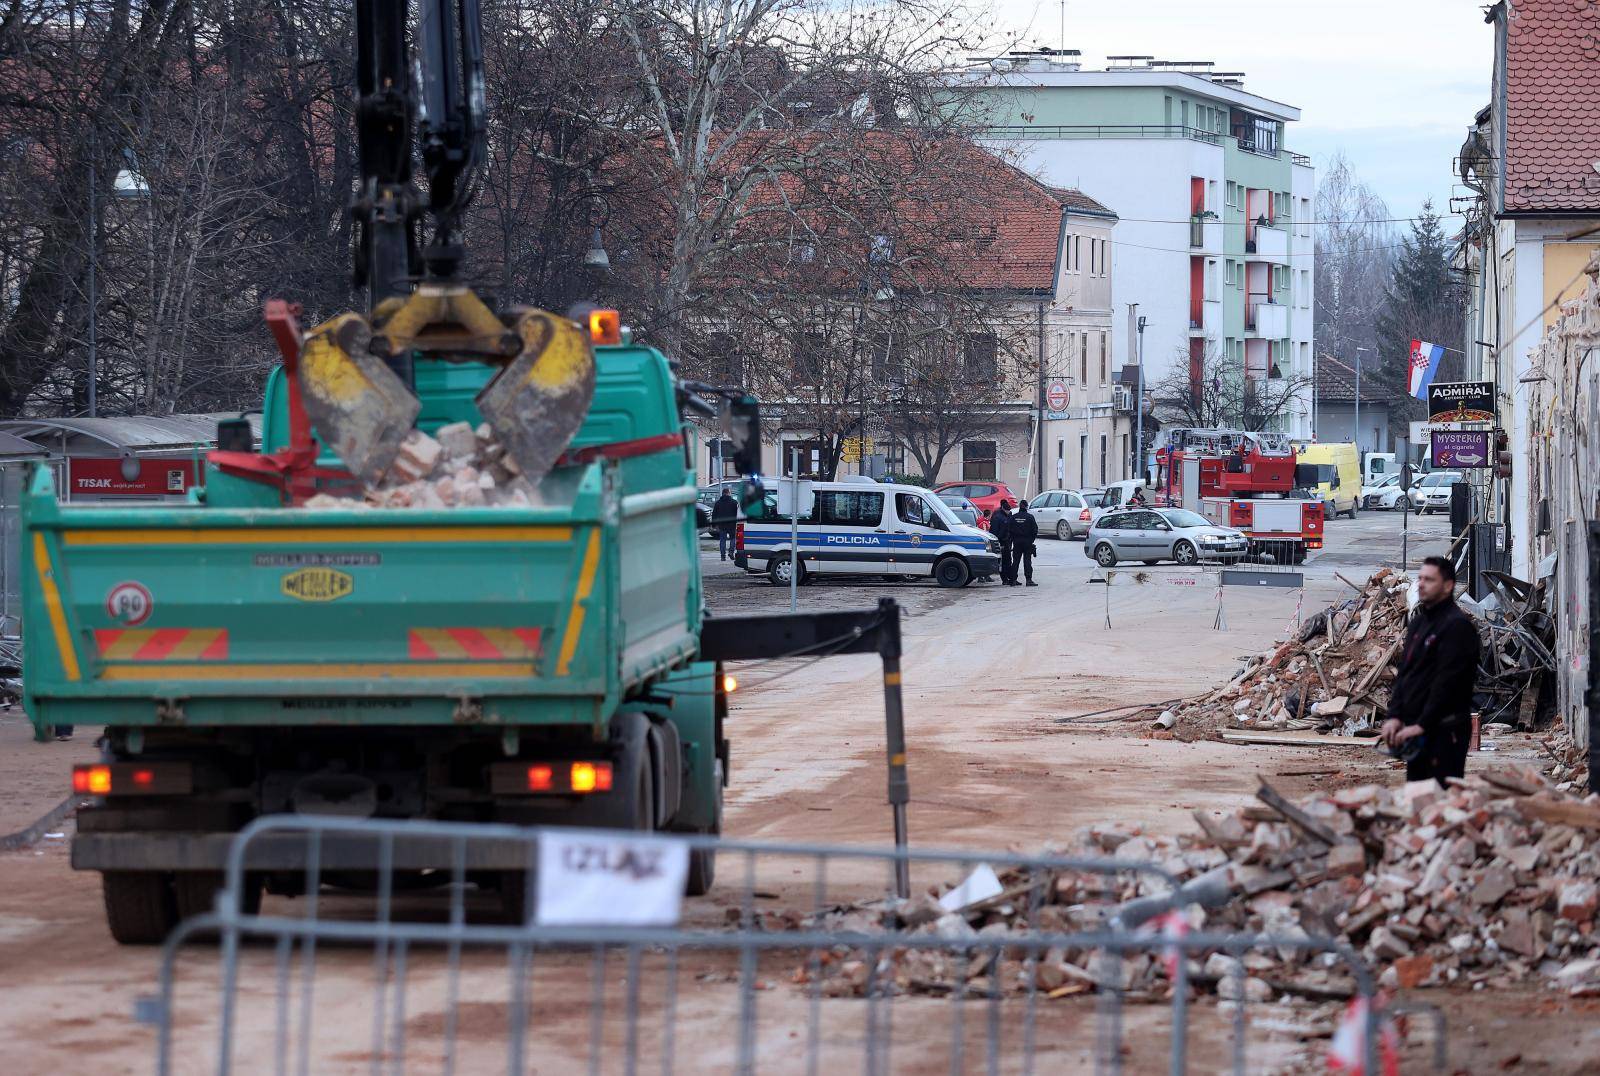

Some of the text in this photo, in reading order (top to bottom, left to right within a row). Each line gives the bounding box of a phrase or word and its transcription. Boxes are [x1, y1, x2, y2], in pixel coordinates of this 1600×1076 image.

[1432, 386, 1490, 398] ADMIRAL
[1437, 433, 1482, 443] MYSTERIA
[78, 478, 112, 488] TISAK
[827, 535, 880, 545] POLICIJA
